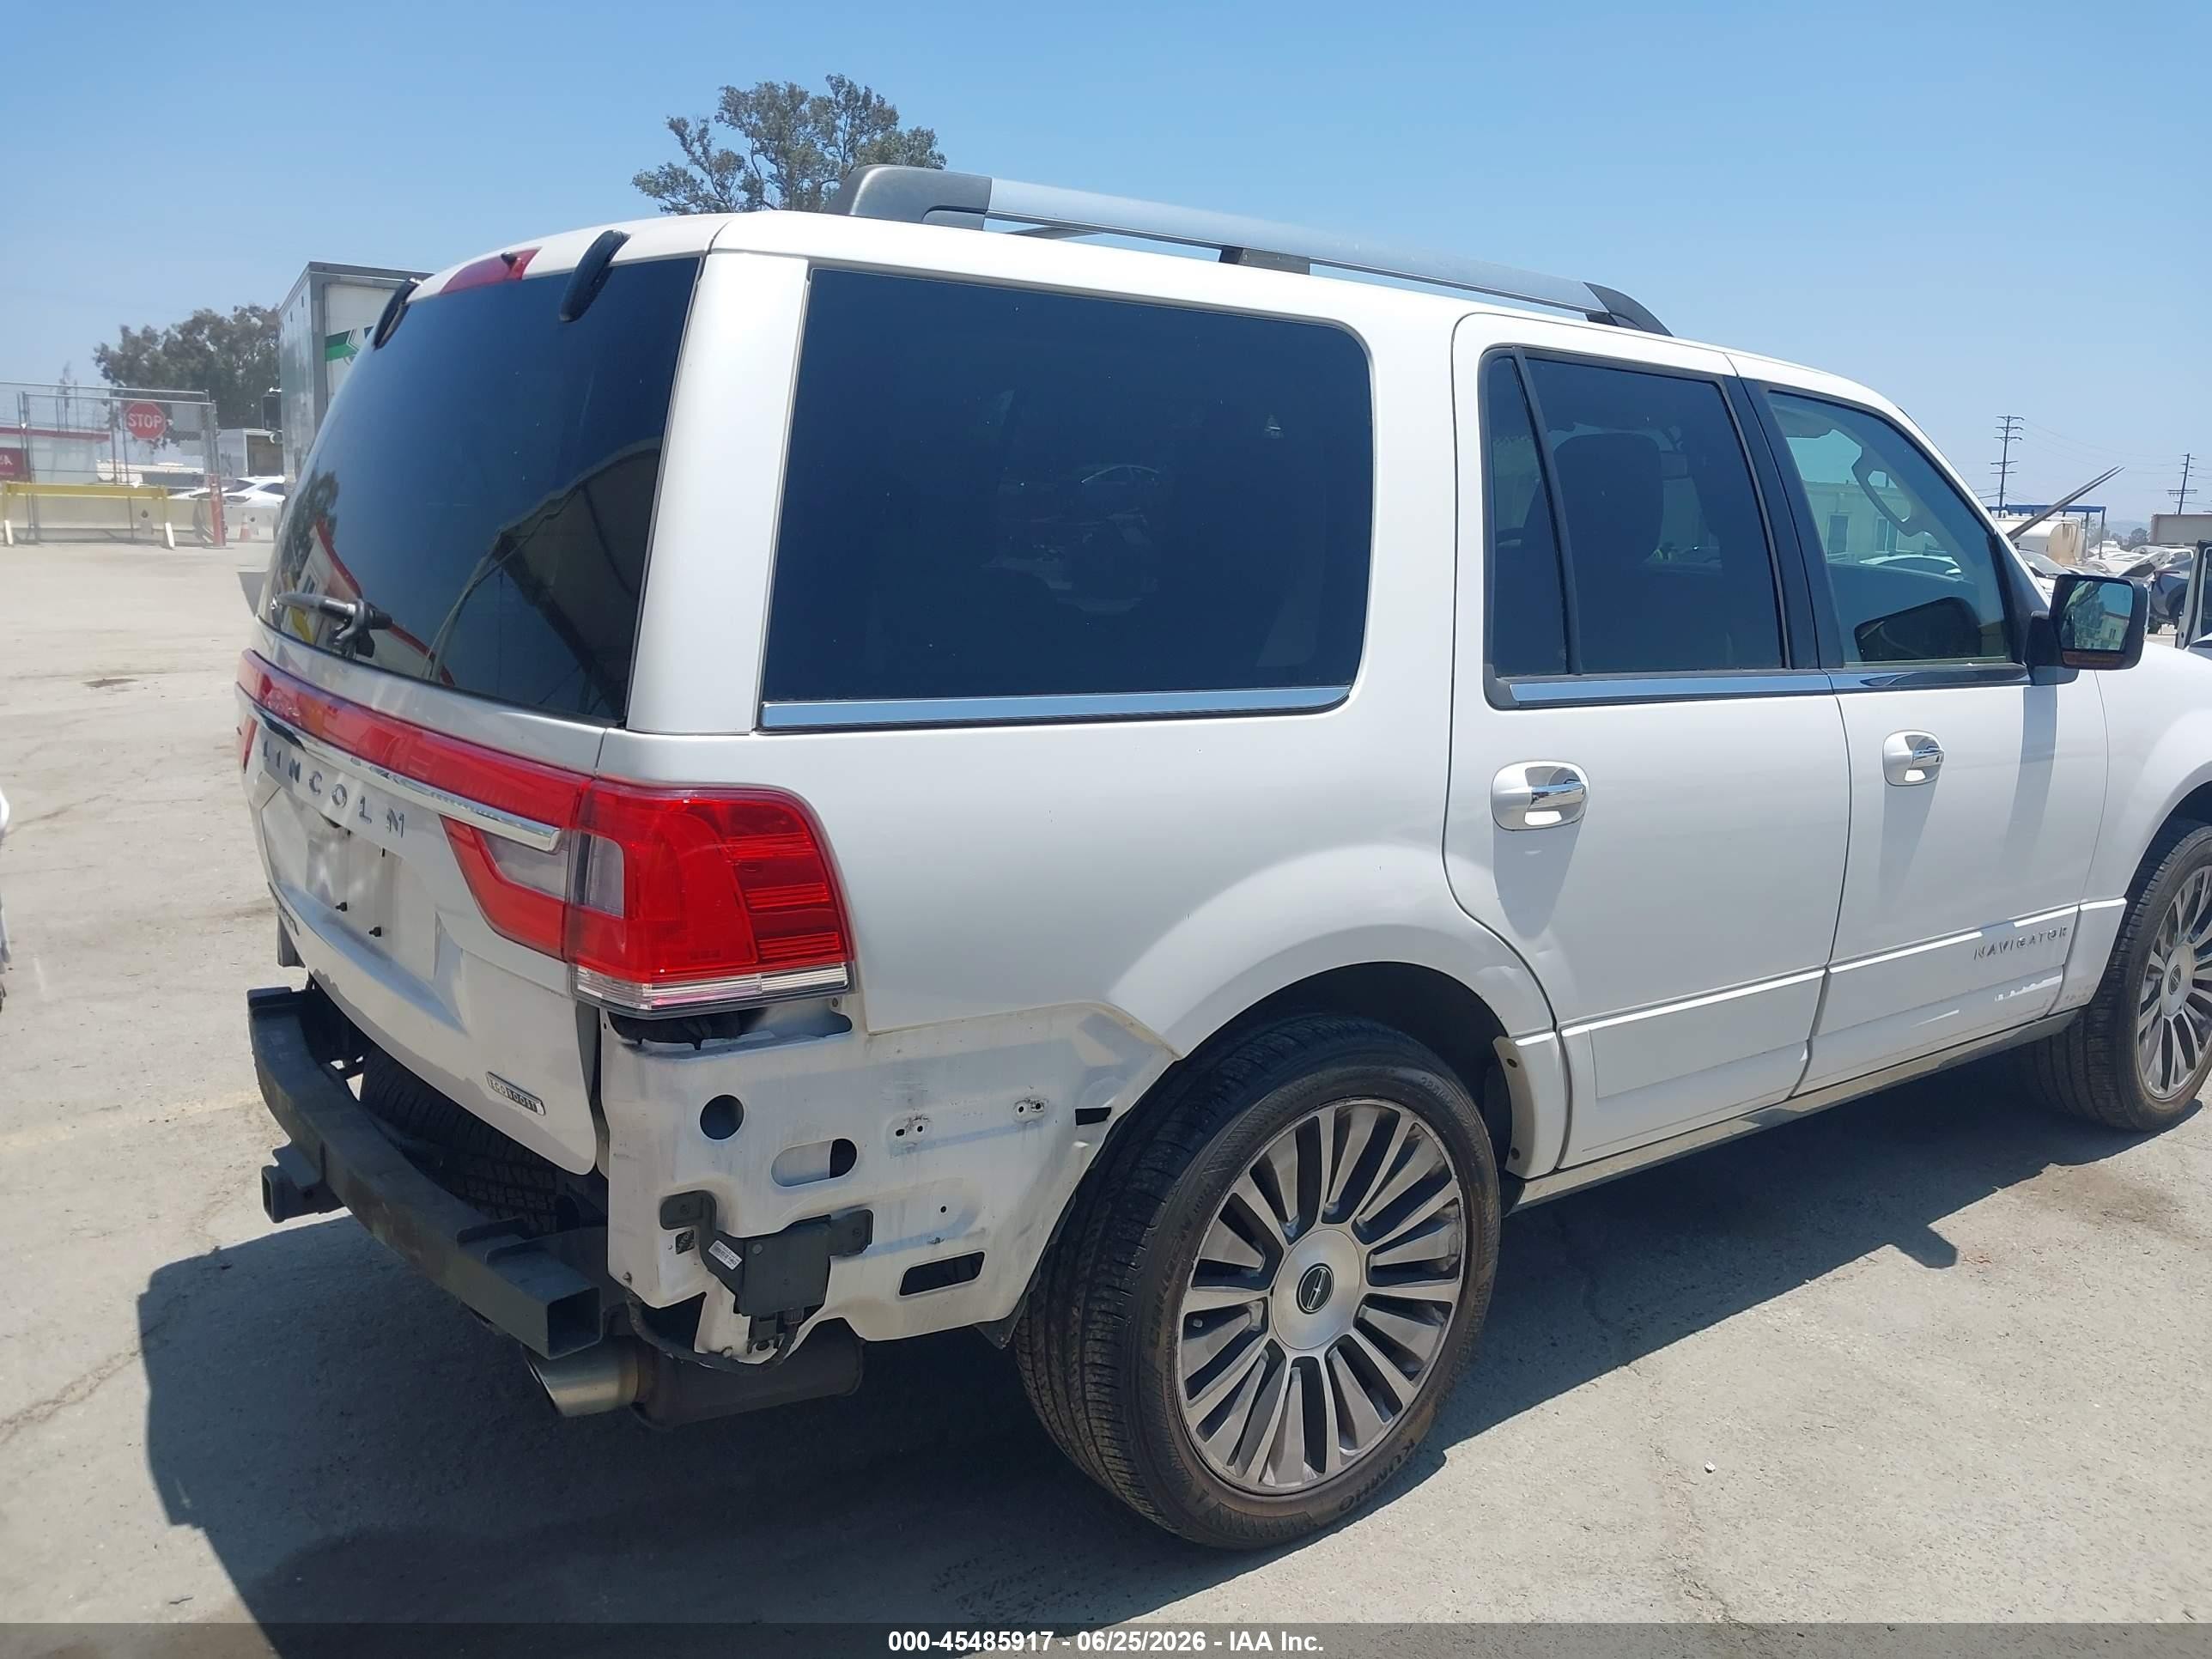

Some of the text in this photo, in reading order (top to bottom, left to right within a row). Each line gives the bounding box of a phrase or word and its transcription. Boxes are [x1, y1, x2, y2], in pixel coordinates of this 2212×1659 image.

[129, 412, 162, 428] STOP
[263, 739, 404, 838] LINCOLN
[1974, 926, 2068, 960] NAVIGATOR
[1339, 1437, 1417, 1513] KUMHO
